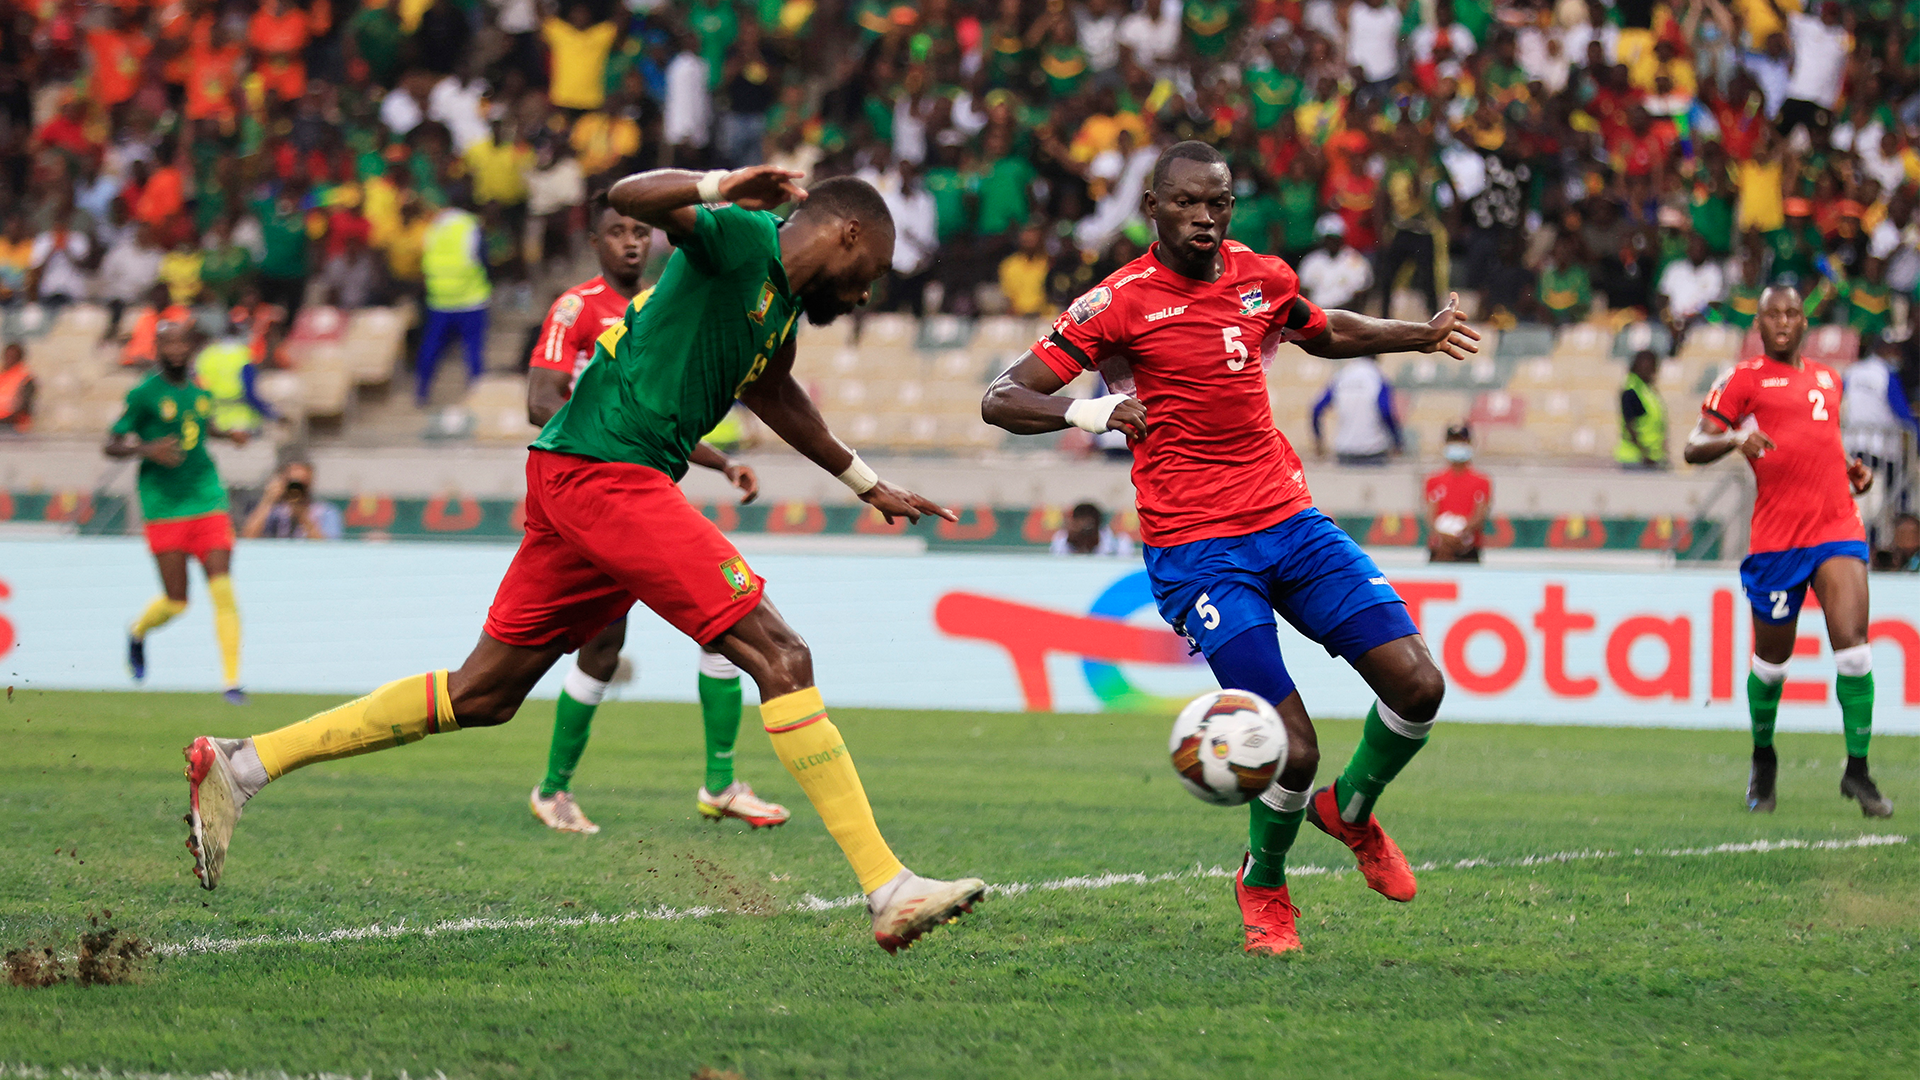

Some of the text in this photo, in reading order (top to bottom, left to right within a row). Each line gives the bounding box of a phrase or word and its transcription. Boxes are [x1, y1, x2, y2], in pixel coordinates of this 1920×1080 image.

[1222, 327, 1248, 371] 5
[1808, 389, 1829, 421] 2
[1195, 592, 1220, 630] 5
[1770, 590, 1790, 619] 2
[793, 758, 807, 771] LE
[808, 750, 832, 766] COQ
